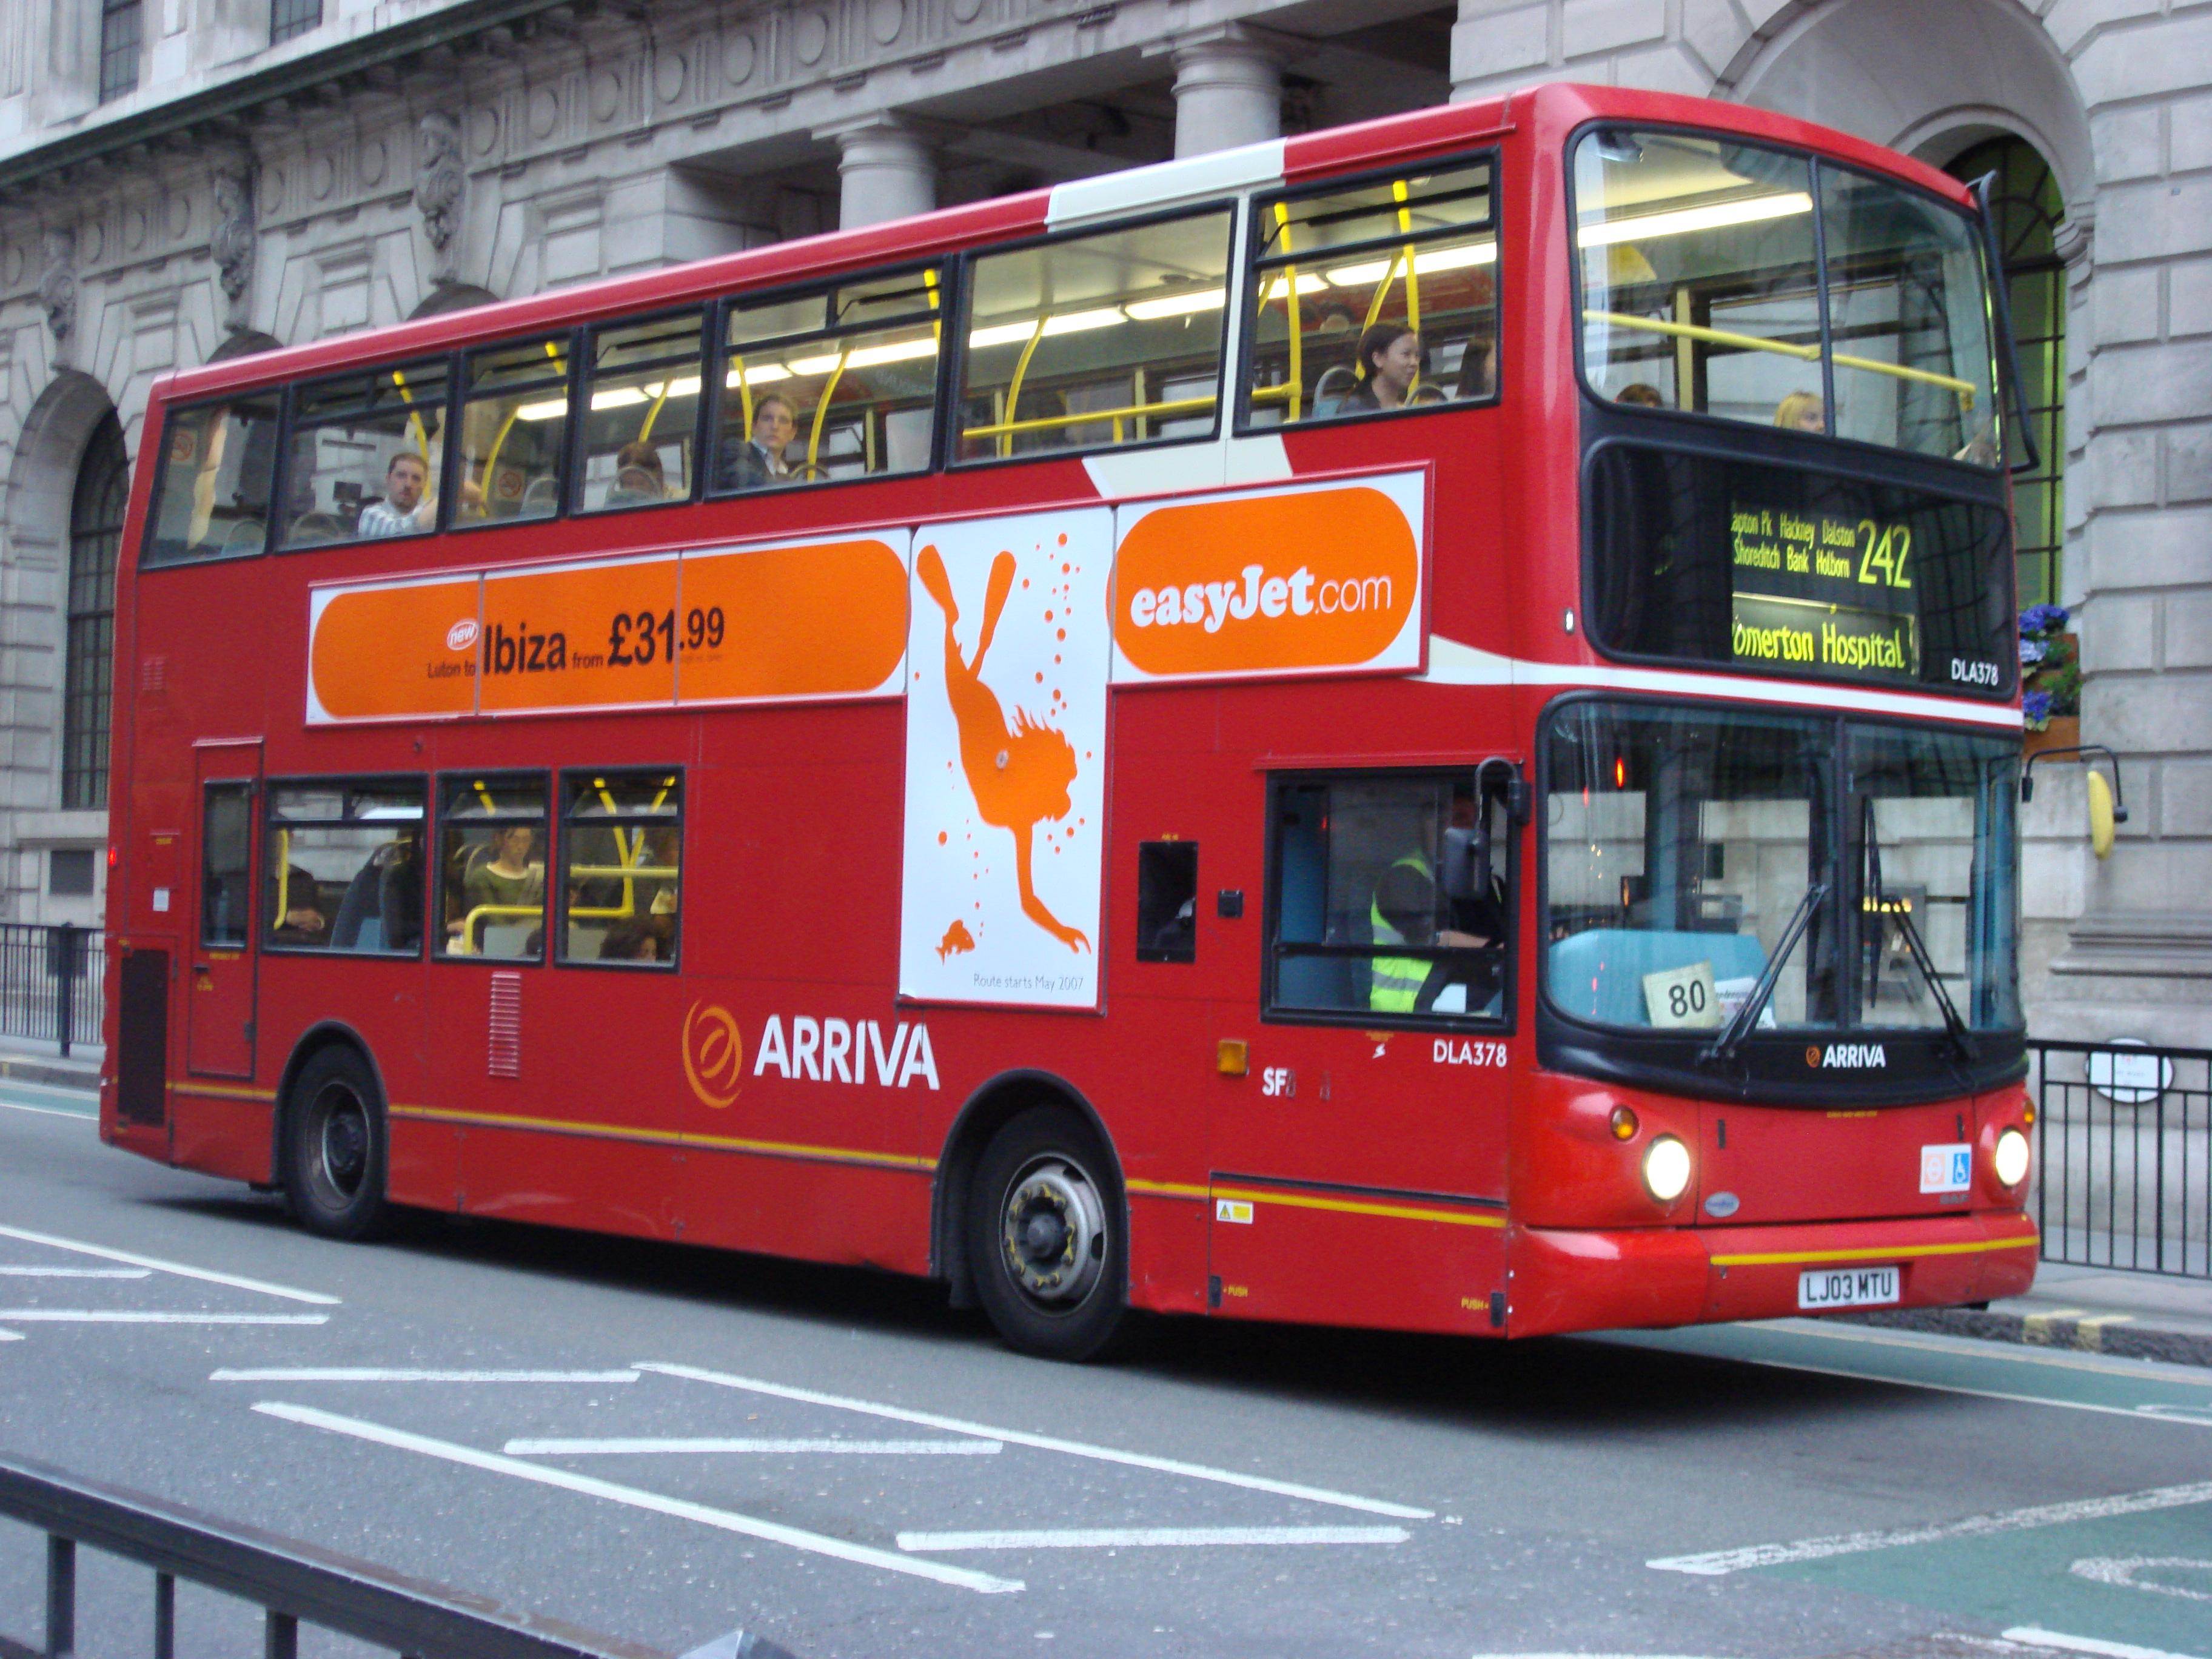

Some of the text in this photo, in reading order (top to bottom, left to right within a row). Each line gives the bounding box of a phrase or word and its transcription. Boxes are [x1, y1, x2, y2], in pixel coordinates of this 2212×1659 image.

[1780, 512, 1815, 550] Hackney
[1822, 518, 1855, 548] Dalston
[1734, 537, 1849, 578] Shoreditch Bank Holborn
[1857, 518, 1912, 589] 242
[1130, 564, 1392, 634] easyJet.com
[427, 661, 461, 679] Luton
[484, 622, 566, 675] Ibiza
[572, 652, 604, 669] from
[608, 607, 725, 666] £31.99
[450, 623, 476, 646] new
[1732, 617, 1906, 669] omerton Hospital
[1951, 657, 1999, 686] DLA378
[973, 973, 1084, 993] Route starts May 2007
[1669, 980, 1706, 1018] 80
[753, 1014, 940, 1091] ARRIVA
[1433, 1037, 1507, 1068] DLA378
[1822, 1043, 1886, 1068] ARRIVA
[1461, 1296, 1484, 1310] PUSH
[1806, 1272, 1892, 1302] LJ03 MTU
